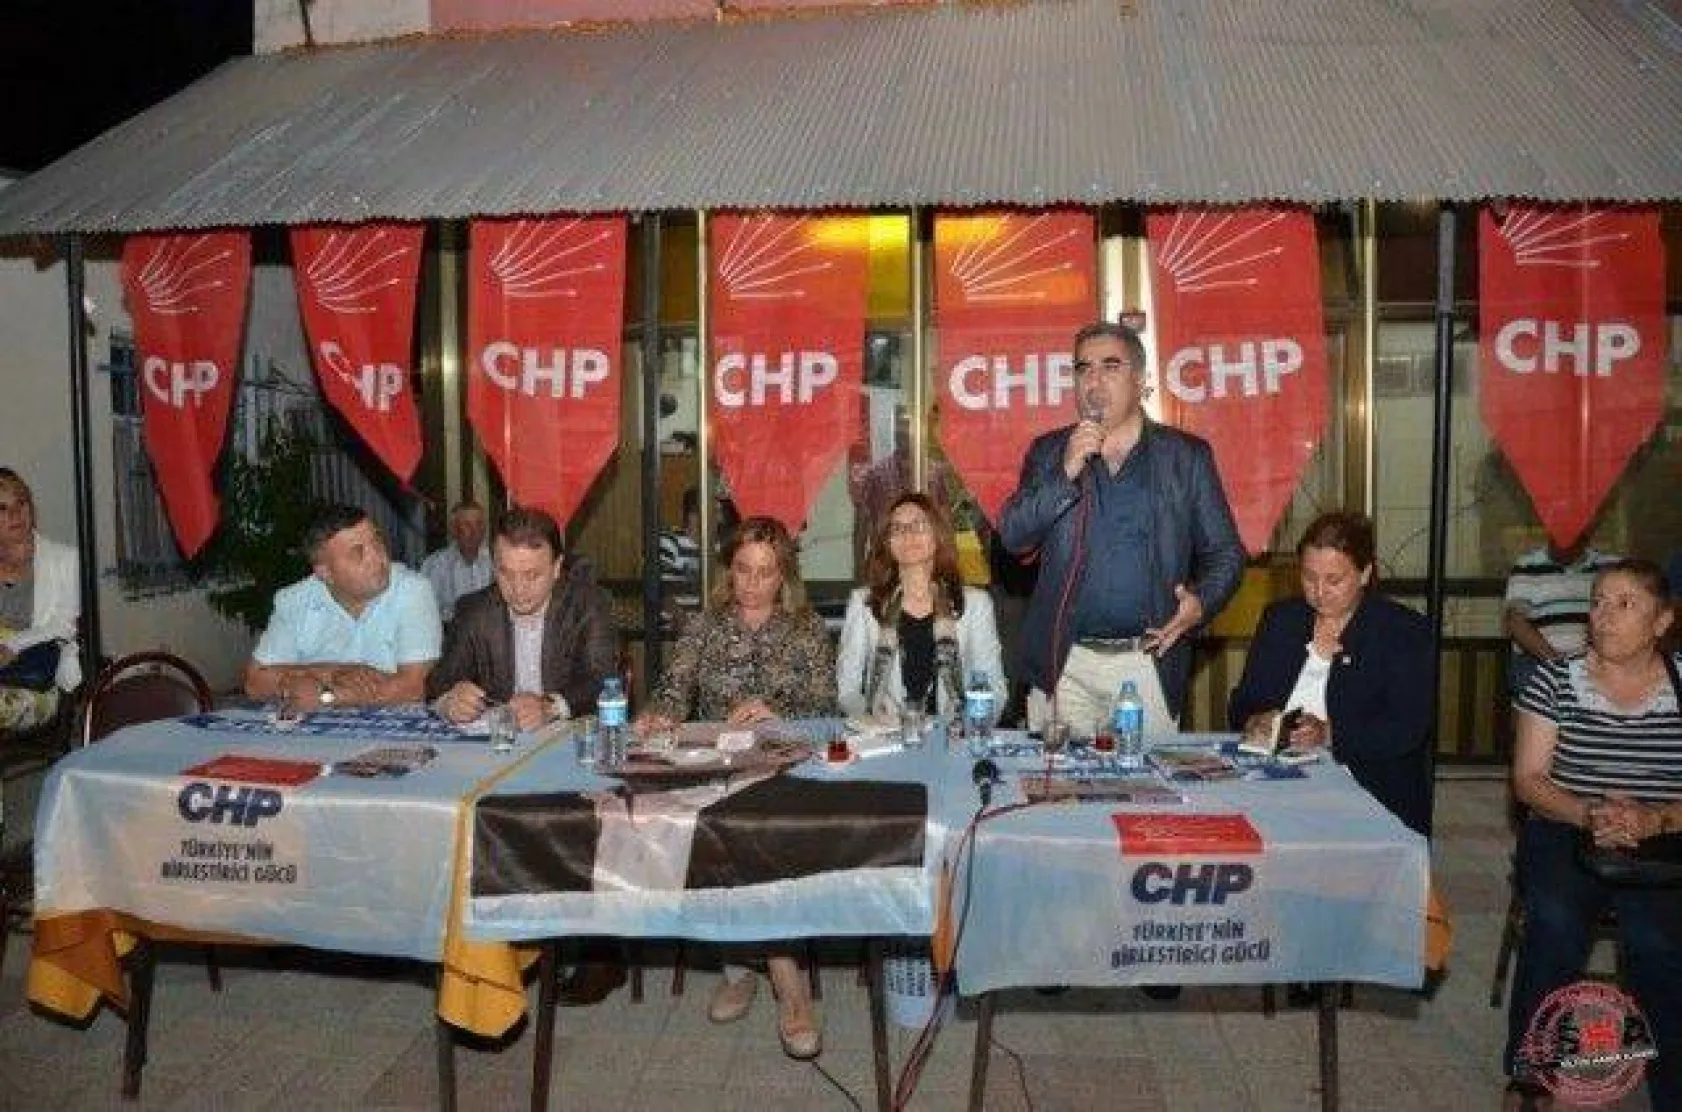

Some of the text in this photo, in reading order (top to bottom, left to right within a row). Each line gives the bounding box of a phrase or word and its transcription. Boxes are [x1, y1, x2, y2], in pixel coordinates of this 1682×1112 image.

[320, 341, 403, 410] CHP
[481, 341, 610, 399] CHP
[1166, 338, 1302, 404] CHP
[1495, 318, 1640, 377] CHP
[145, 356, 219, 408] CHP
[714, 351, 839, 407] CHP
[178, 783, 283, 828] CHP
[1131, 862, 1254, 905] CHP
